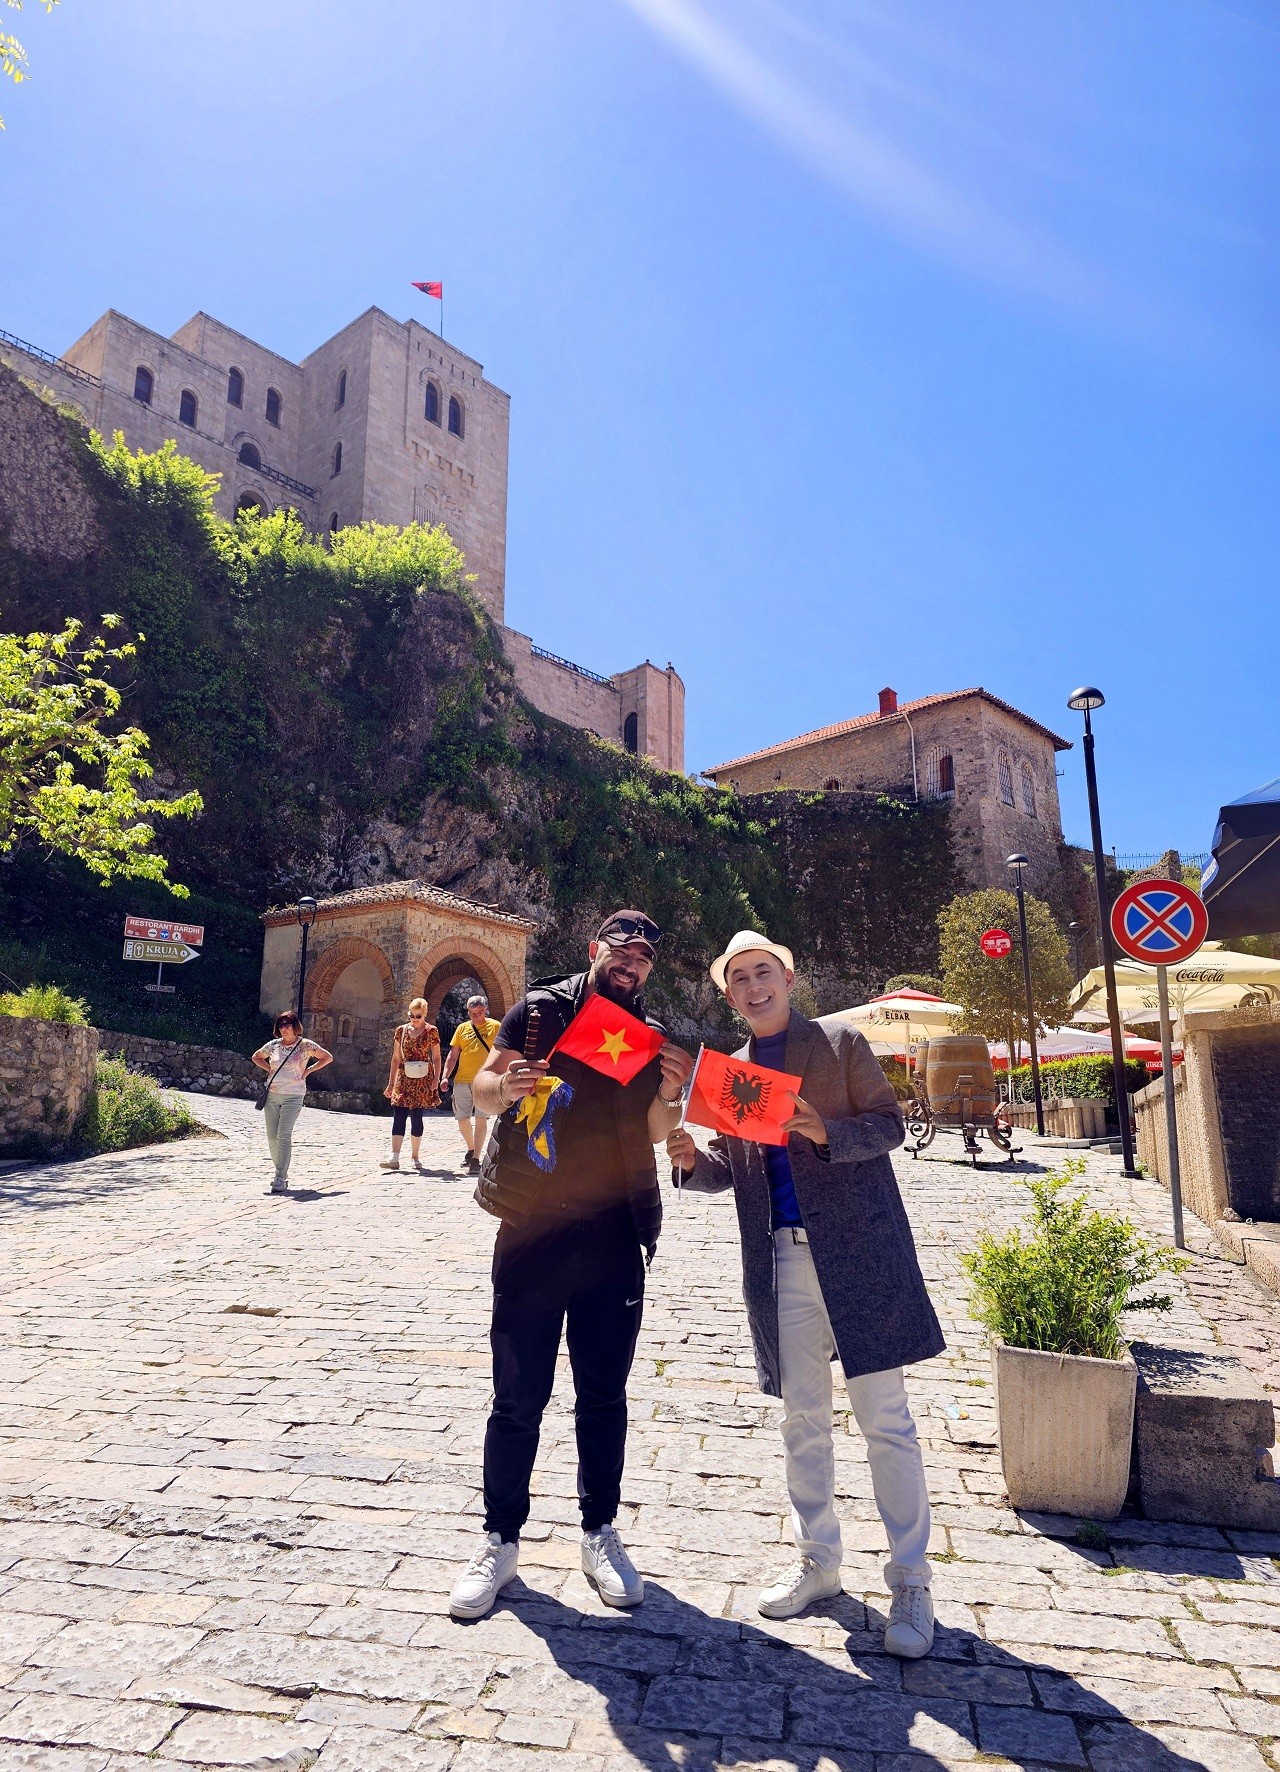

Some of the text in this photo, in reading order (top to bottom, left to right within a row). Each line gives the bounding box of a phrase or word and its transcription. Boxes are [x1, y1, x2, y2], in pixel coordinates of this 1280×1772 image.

[129, 919, 200, 934] RESTORANT BARDHI
[146, 945, 179, 955] KRUJA
[885, 1010, 910, 1021] ELBAR
